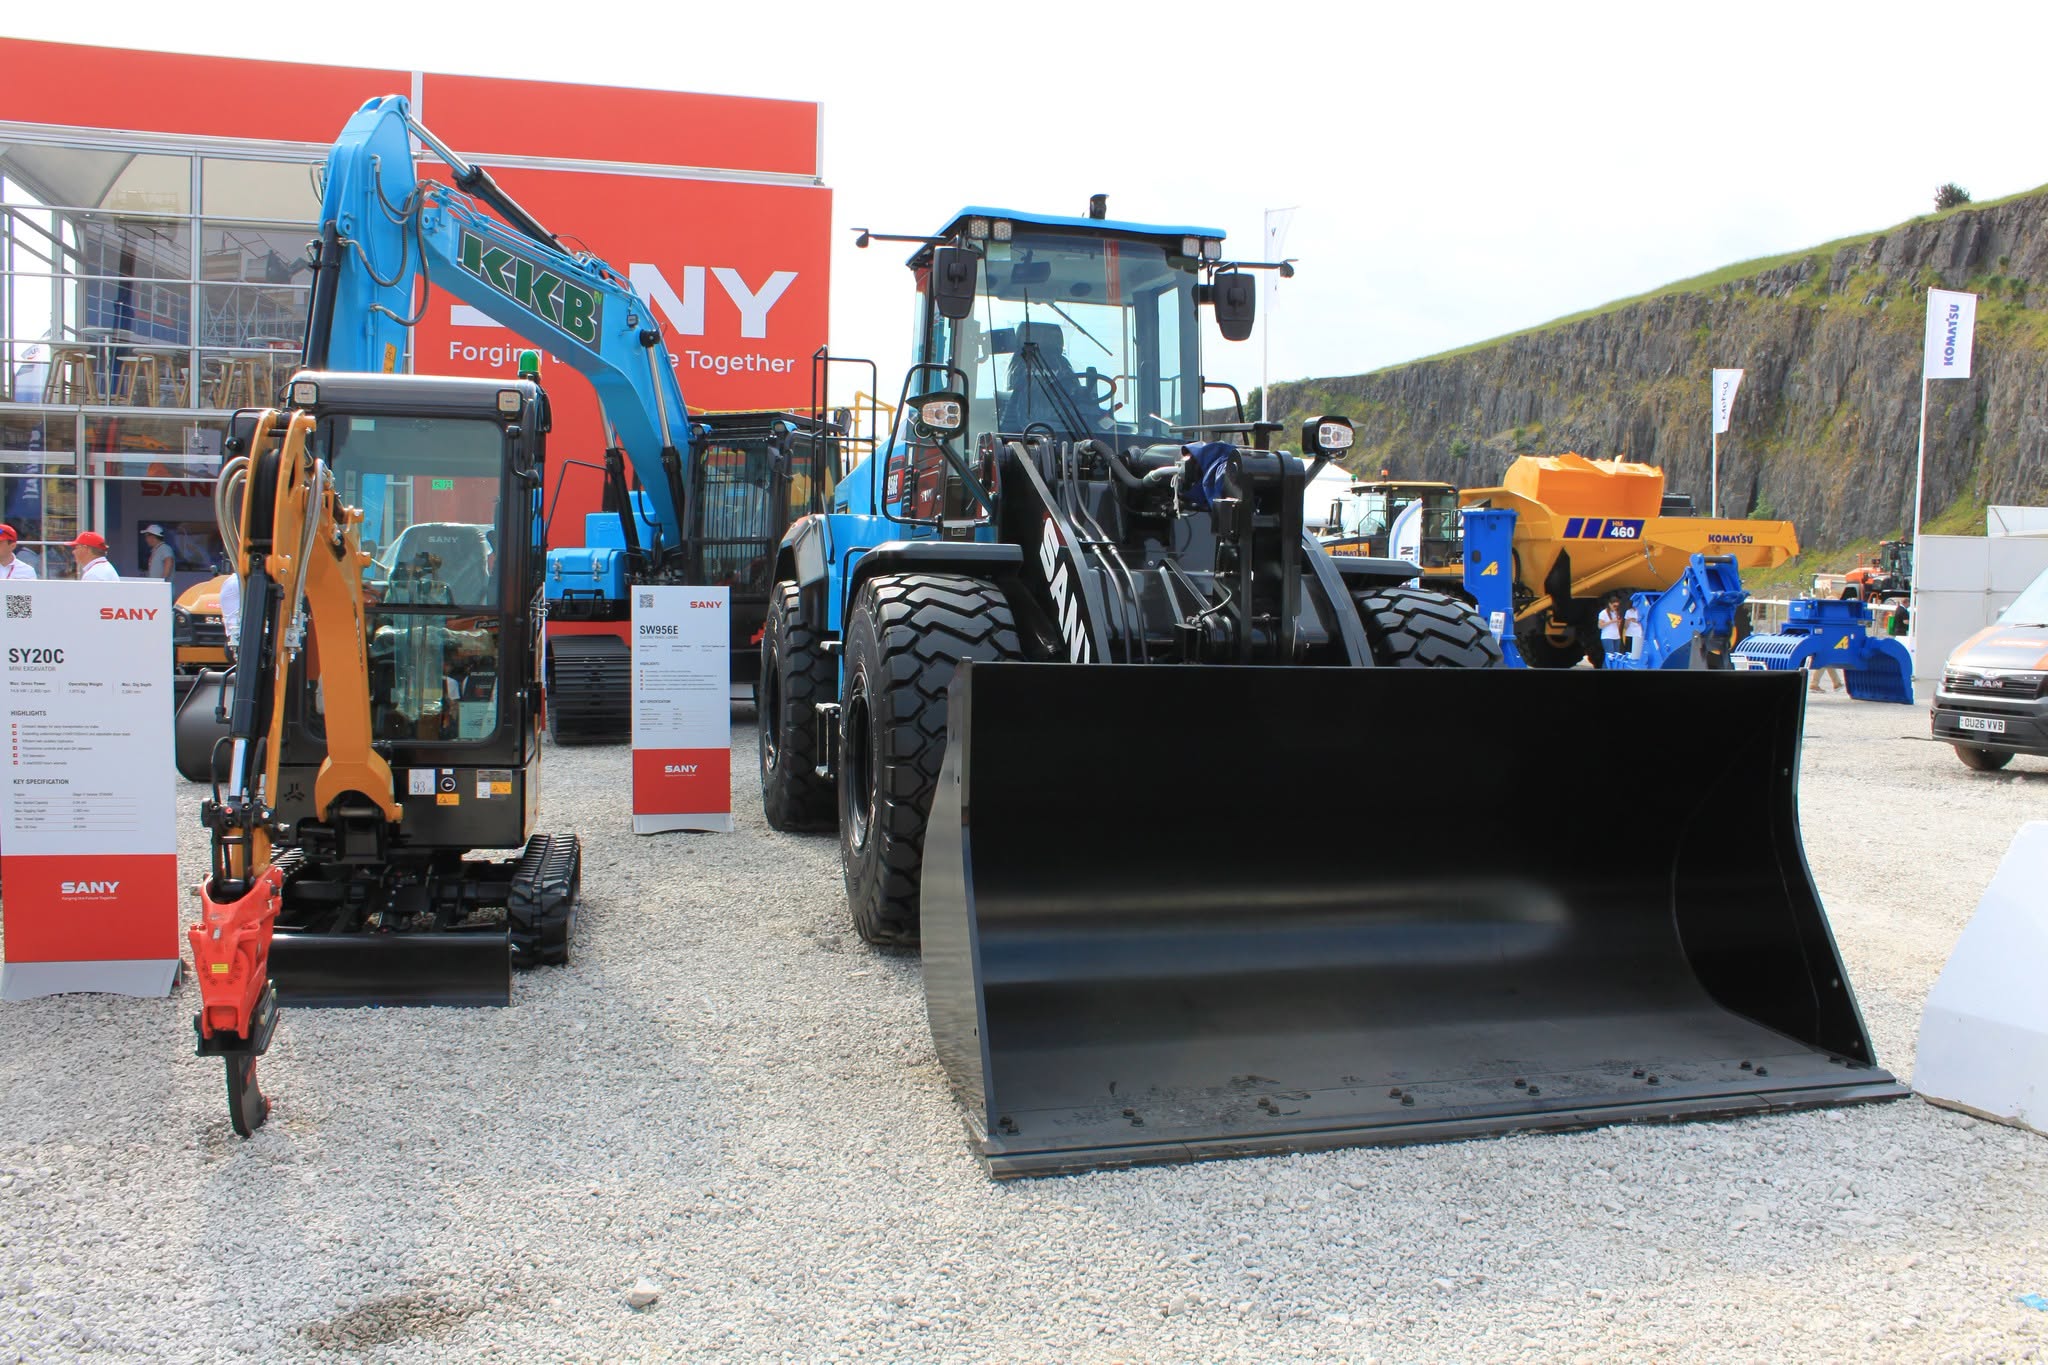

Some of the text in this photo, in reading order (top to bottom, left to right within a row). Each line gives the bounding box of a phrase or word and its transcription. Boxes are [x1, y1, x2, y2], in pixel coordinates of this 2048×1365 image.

[461, 230, 597, 344] KKB
[1943, 303, 1960, 367] KOMATSU
[685, 350, 795, 376] Together
[140, 480, 211, 497] SAN
[1610, 526, 1636, 539] 460
[1707, 532, 1754, 544] KOMATSU
[427, 535, 458, 544] SANY
[690, 601, 722, 609] SANY
[99, 607, 159, 621] SANY
[639, 625, 679, 635] SW956E
[8, 648, 65, 664] SY20C
[1973, 679, 2003, 688] MAN
[1964, 718, 2004, 731] OU26 VVB
[664, 764, 698, 773] SANY
[61, 881, 120, 895] SANY
